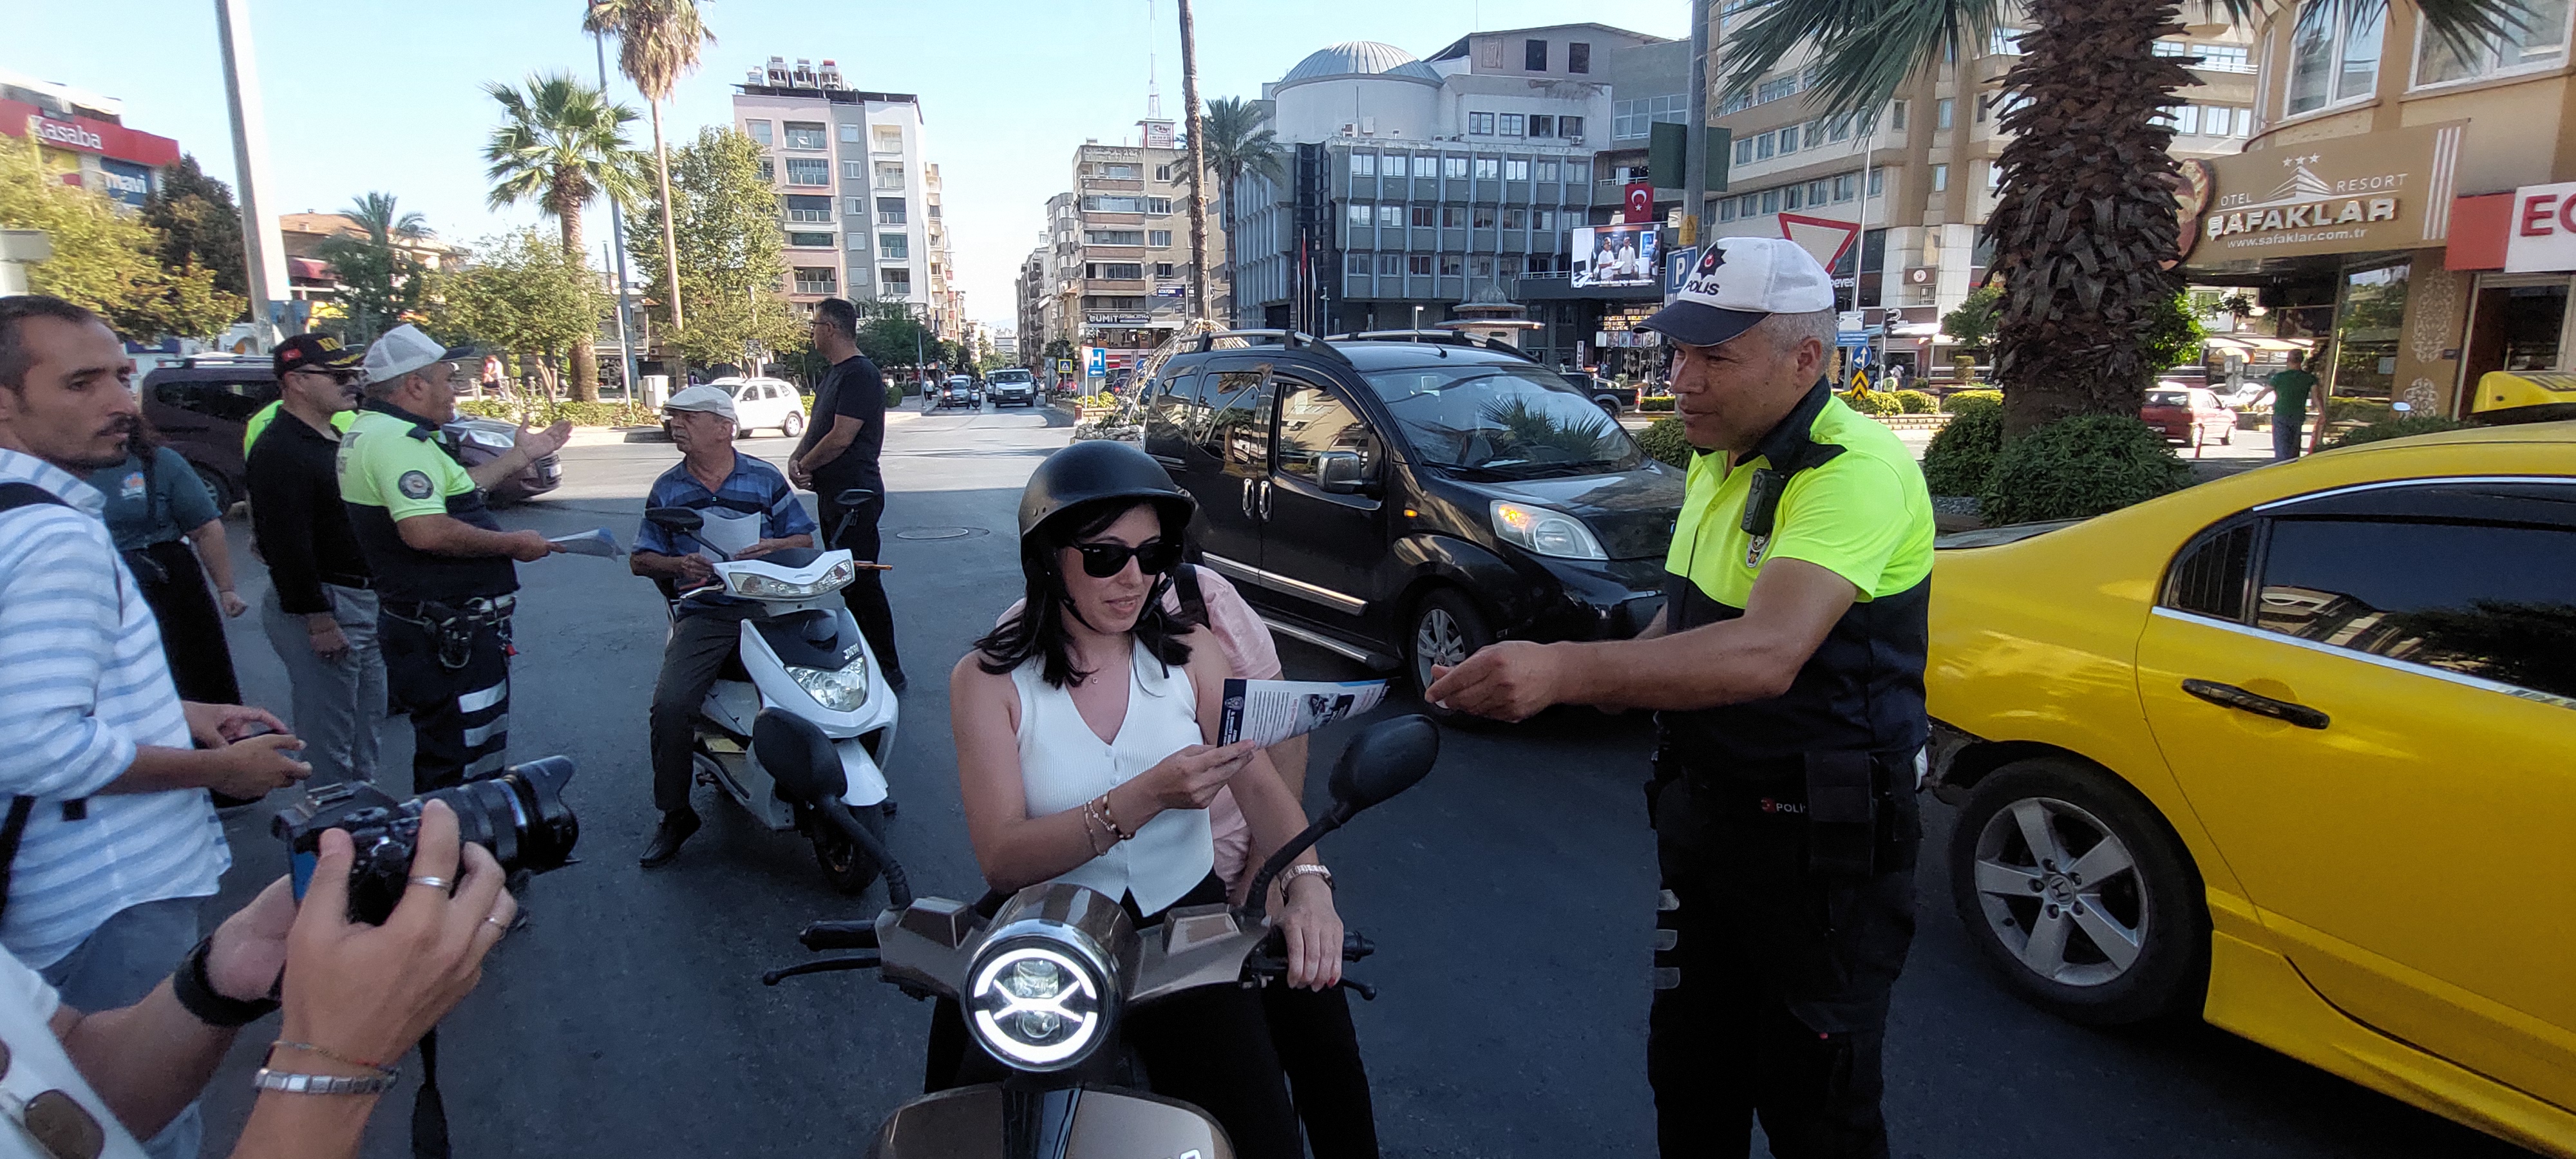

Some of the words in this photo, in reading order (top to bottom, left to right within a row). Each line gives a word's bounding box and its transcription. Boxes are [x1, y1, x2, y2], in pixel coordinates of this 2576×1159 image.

[30, 114, 104, 149] Kasaba
[2221, 193, 2253, 207] OTEL
[2336, 173, 2409, 193] RESORT
[2207, 198, 2398, 241] ŞAFAKLAR
[2228, 227, 2367, 249] www.safaklar.com.tr
[1675, 257, 1686, 285] P
[1091, 351, 1102, 366] H
[1776, 803, 1806, 813] POLI
